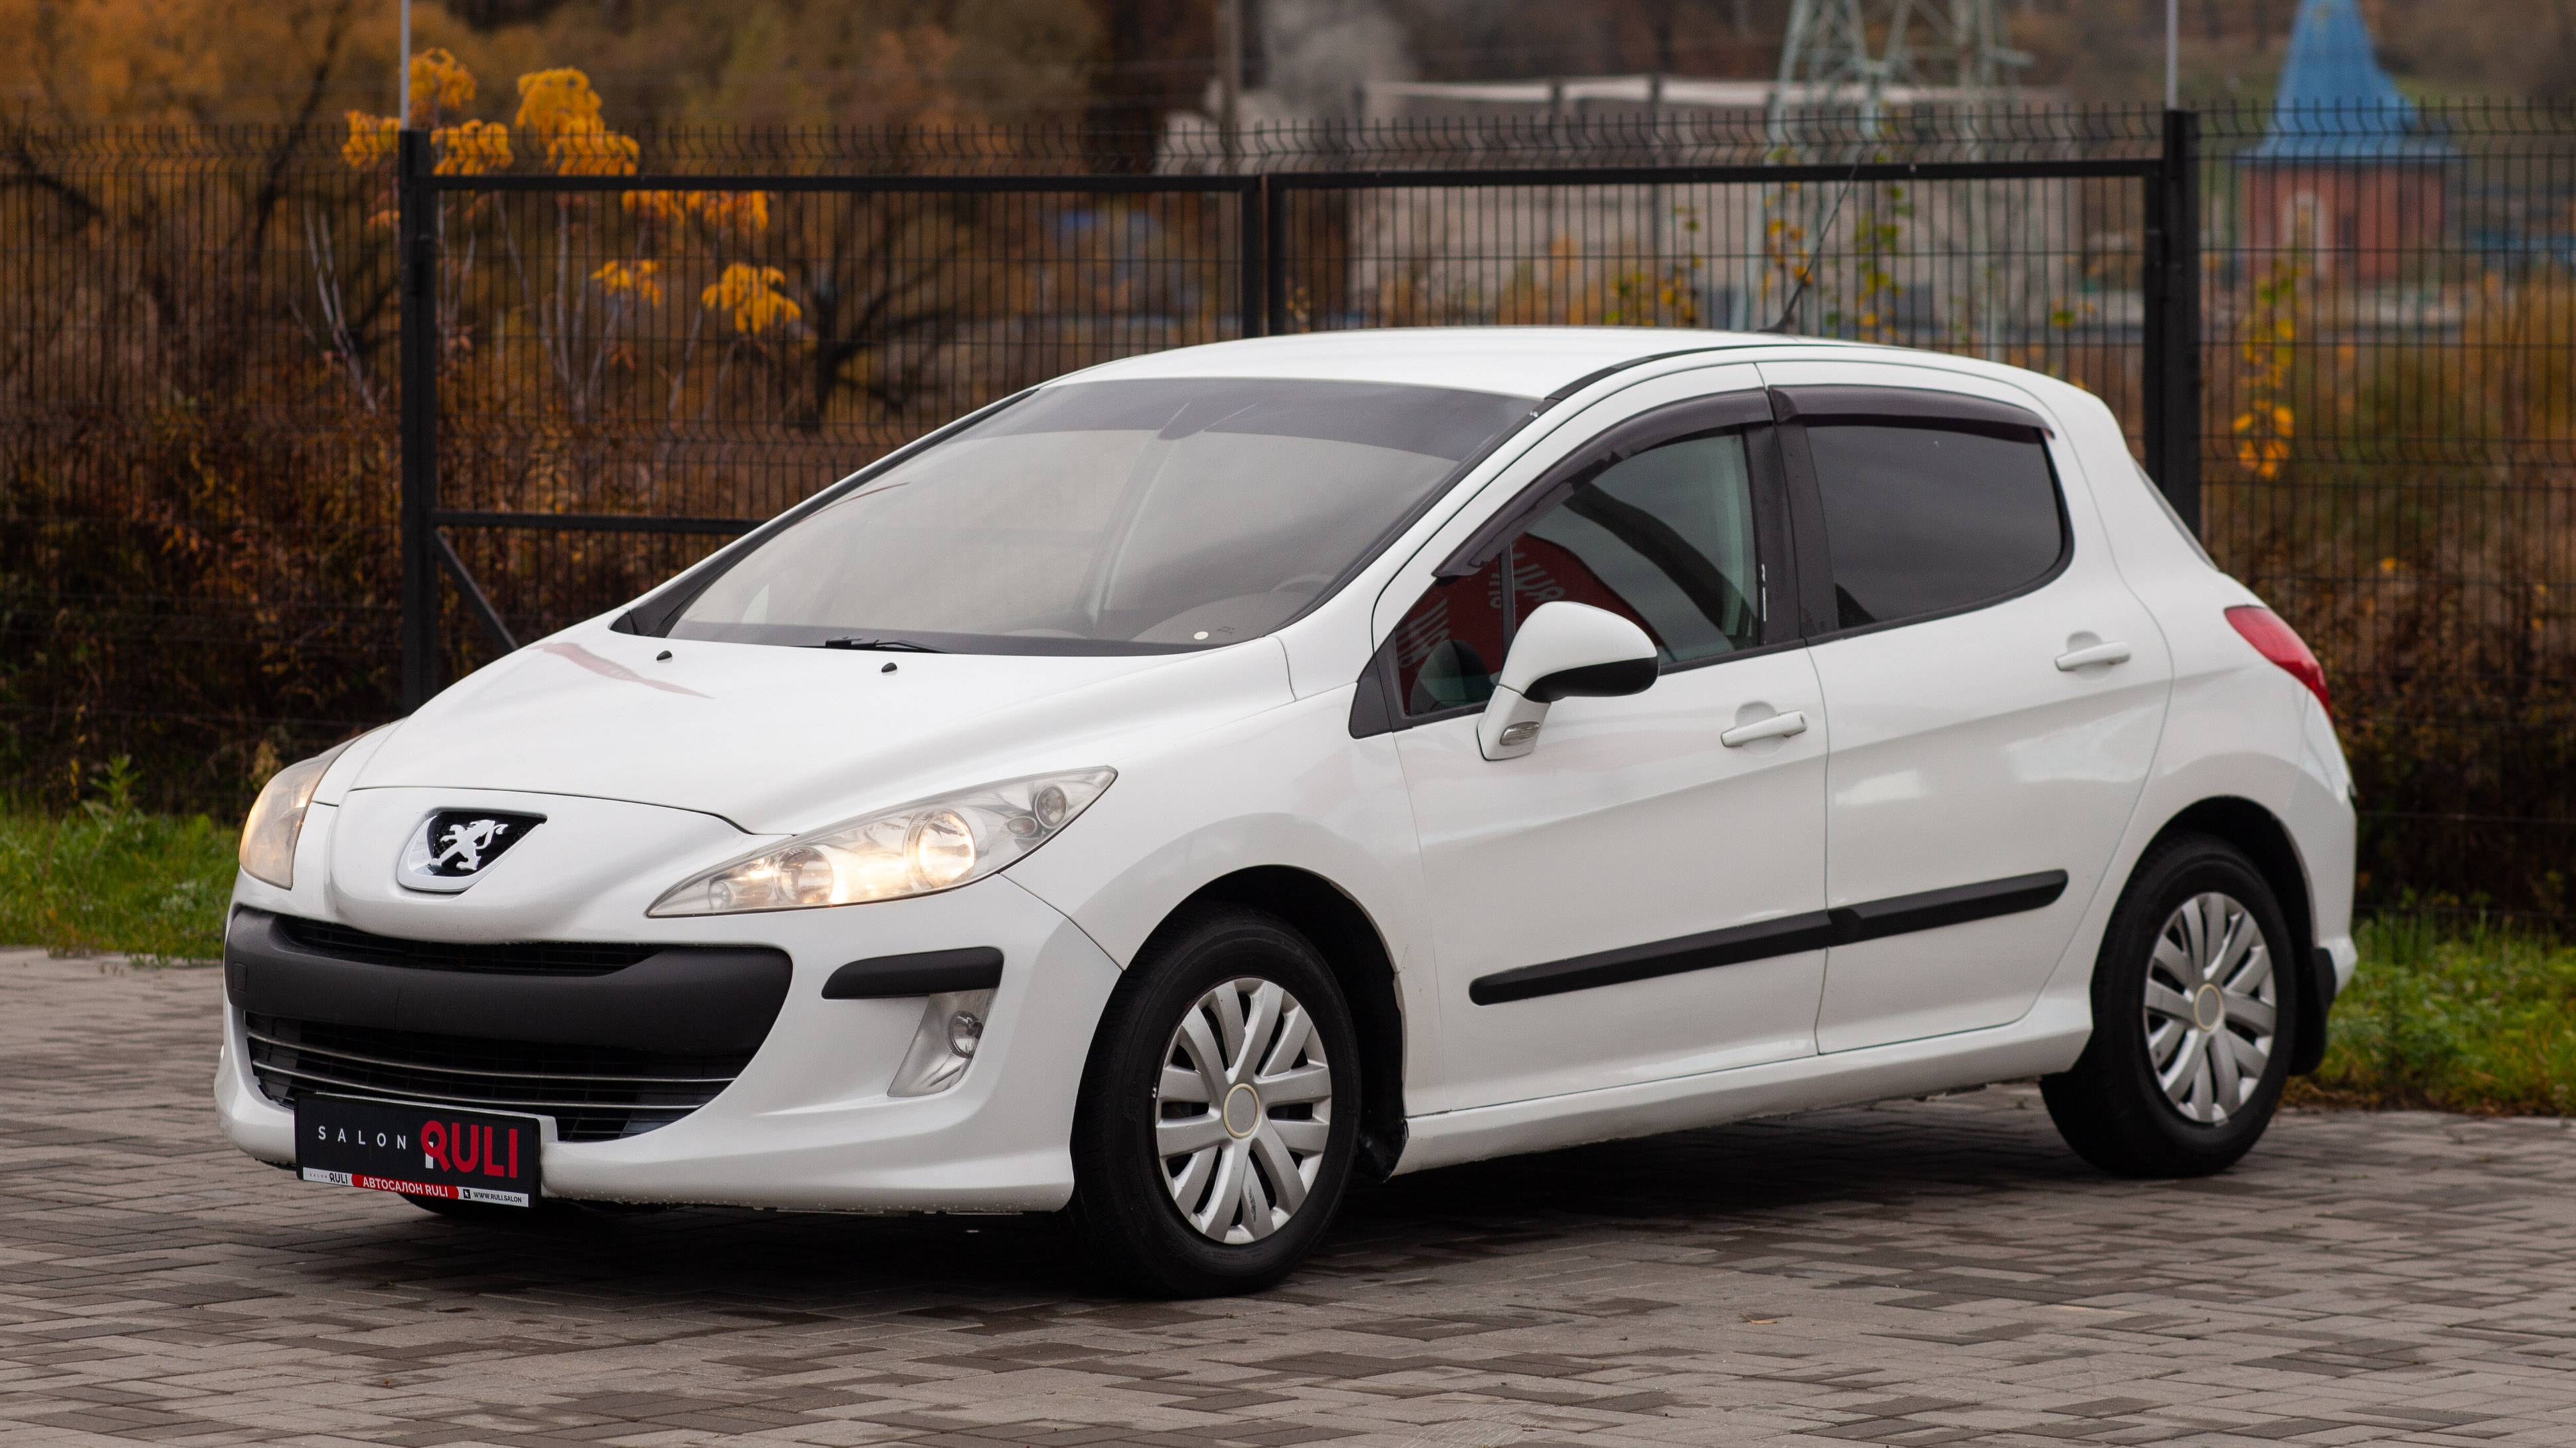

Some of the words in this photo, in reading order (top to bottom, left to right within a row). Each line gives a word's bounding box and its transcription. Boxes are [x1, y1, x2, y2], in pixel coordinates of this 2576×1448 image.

[318, 1125, 407, 1149] SALON
[421, 1120, 518, 1178] RULI
[330, 1173, 348, 1185] RULI
[363, 1177, 423, 1194] АВТОСАЛОН
[425, 1185, 448, 1197] RULI
[474, 1192, 522, 1202] WWW.RULI.SALON
